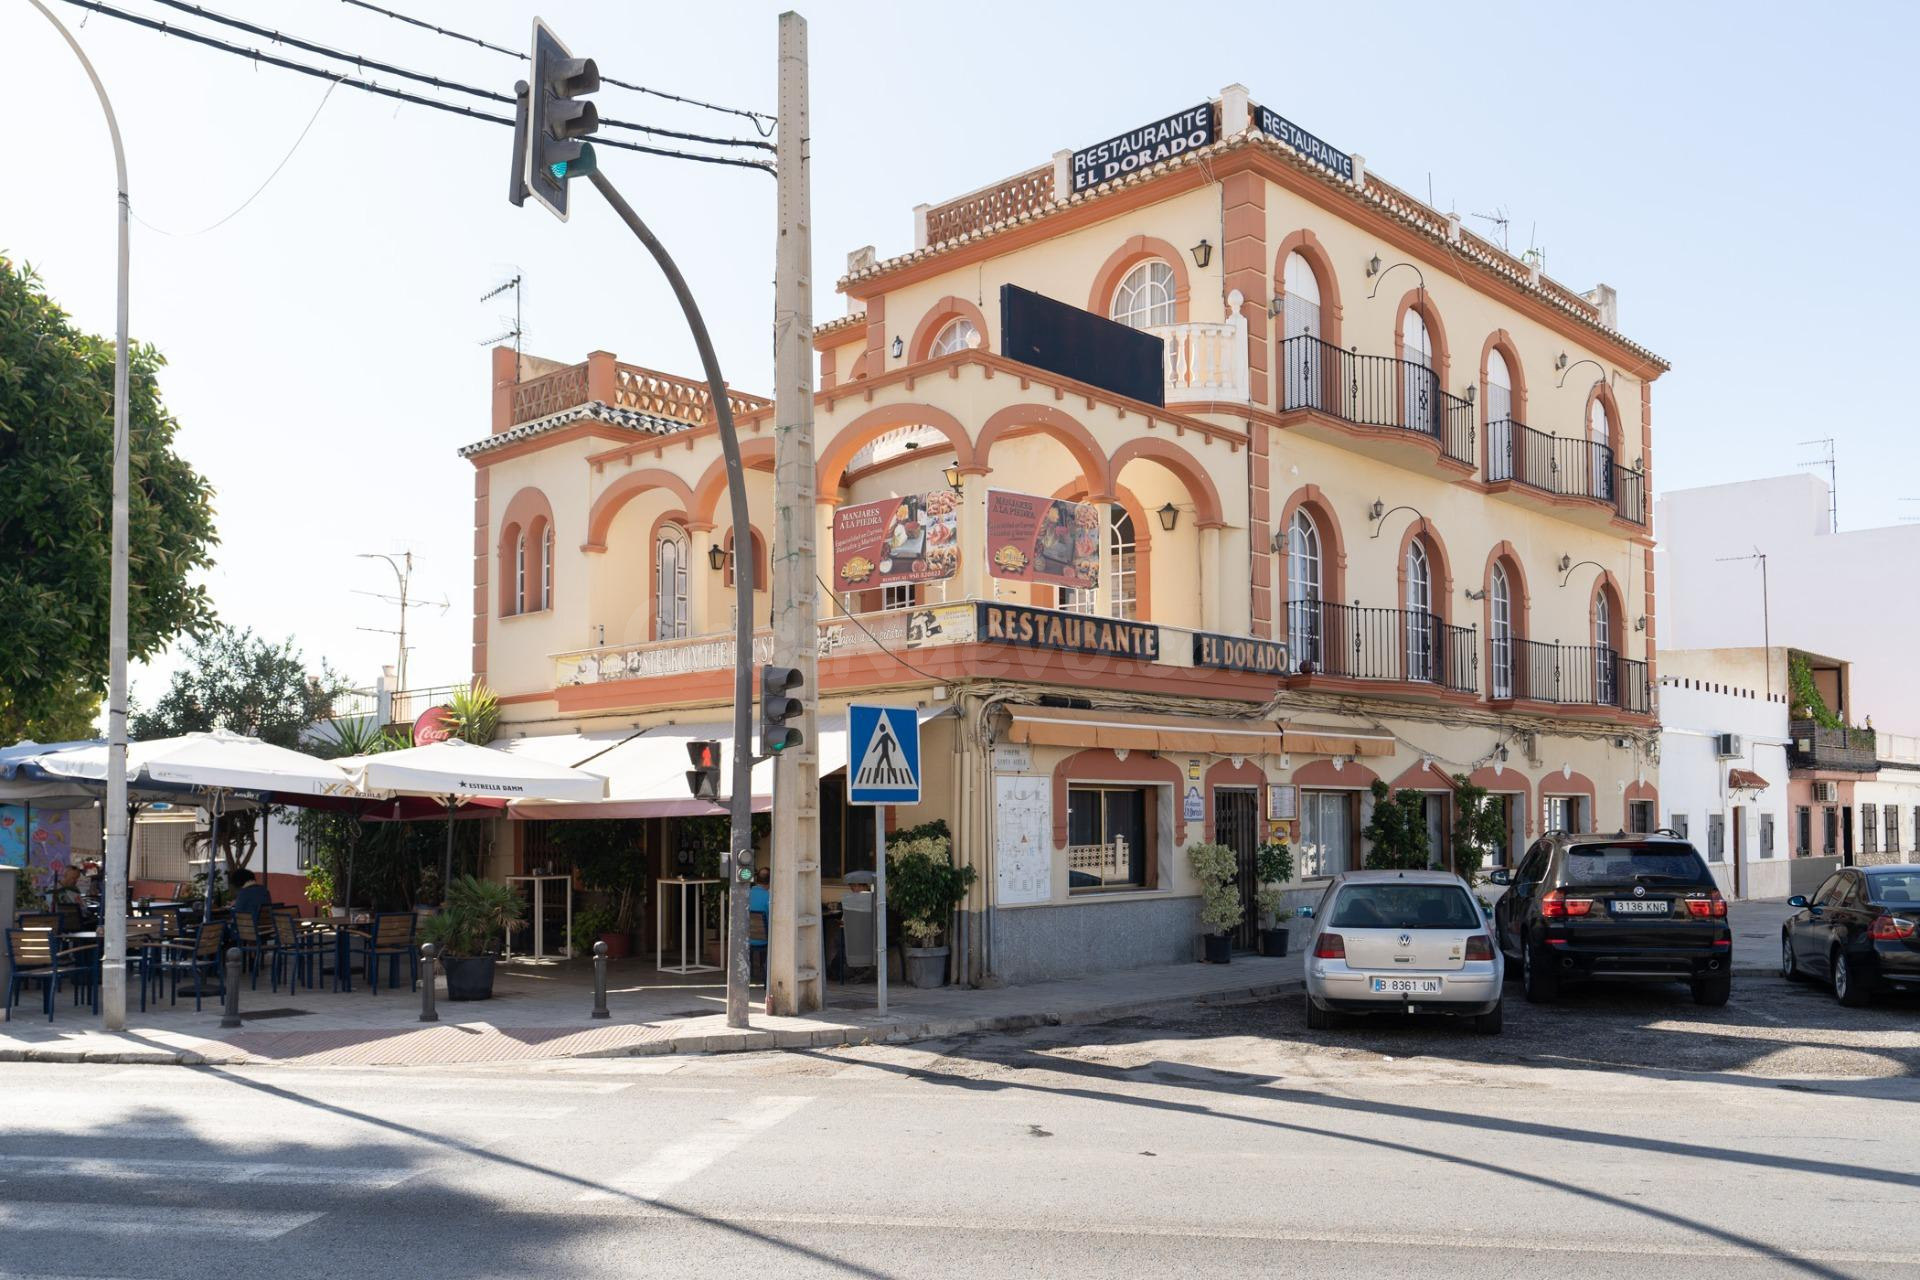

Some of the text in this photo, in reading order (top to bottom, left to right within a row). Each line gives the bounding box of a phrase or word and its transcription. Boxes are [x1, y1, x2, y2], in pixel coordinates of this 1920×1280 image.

[1074, 107, 1207, 173] RESTAURANTE
[1262, 109, 1351, 176] RESTAURANTE
[1075, 130, 1207, 190] EL DORADO
[842, 507, 880, 521] MANJARES
[845, 520, 855, 529] LA
[854, 516, 882, 528] PIEDRA
[988, 607, 1156, 656] RESTAURANTE
[641, 648, 679, 675] STEAK
[682, 646, 699, 670] ON
[702, 642, 727, 669] THE
[1202, 637, 1288, 673] EL DORADO
[469, 783, 501, 791] ESTRELLA
[1617, 902, 1667, 912] 3136 KNG
[1380, 981, 1436, 991] B 8361 UN
